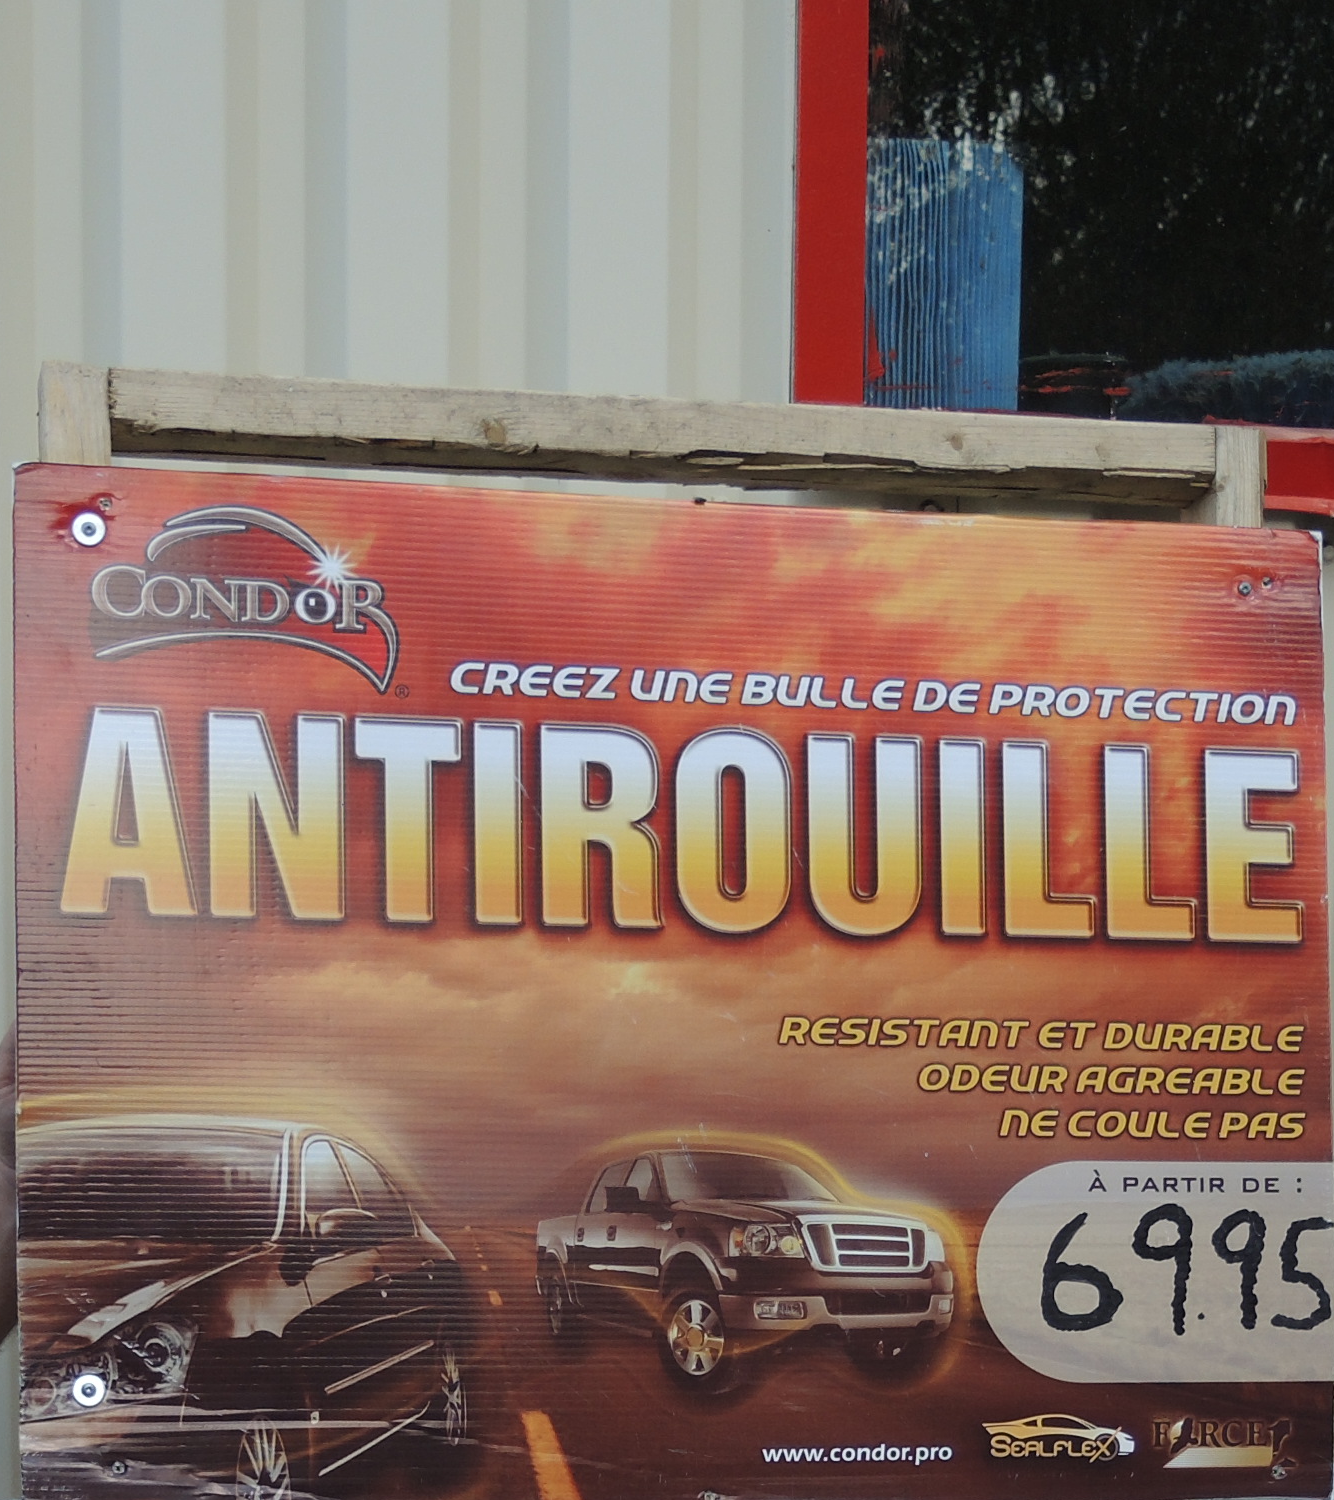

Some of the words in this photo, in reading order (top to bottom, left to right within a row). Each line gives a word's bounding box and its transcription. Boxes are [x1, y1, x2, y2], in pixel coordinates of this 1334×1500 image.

[91, 564, 389, 634] CONDOR
[450, 661, 621, 699] CREEZ
[630, 669, 733, 704] UNE
[740, 672, 906, 711] BULLE
[912, 681, 982, 714] DE
[988, 683, 1298, 726] PROTECTION
[59, 704, 1306, 946] ANTIROUILLE
[778, 1015, 1029, 1049] RESISTANT
[1038, 1019, 1096, 1050] ET
[1102, 1021, 1306, 1053] DURABLE
[917, 1063, 1068, 1093] ODEUR
[1074, 1065, 1306, 1098] AGREABLE
[998, 1108, 1059, 1137] NE
[1066, 1108, 1211, 1139] COULE
[1218, 1109, 1306, 1140] PAS
[1087, 1169, 1108, 1193] À
[1122, 1176, 1226, 1194] PARTIR
[1241, 1176, 1280, 1194] DE
[761, 1442, 953, 1467] www.condor.pro
